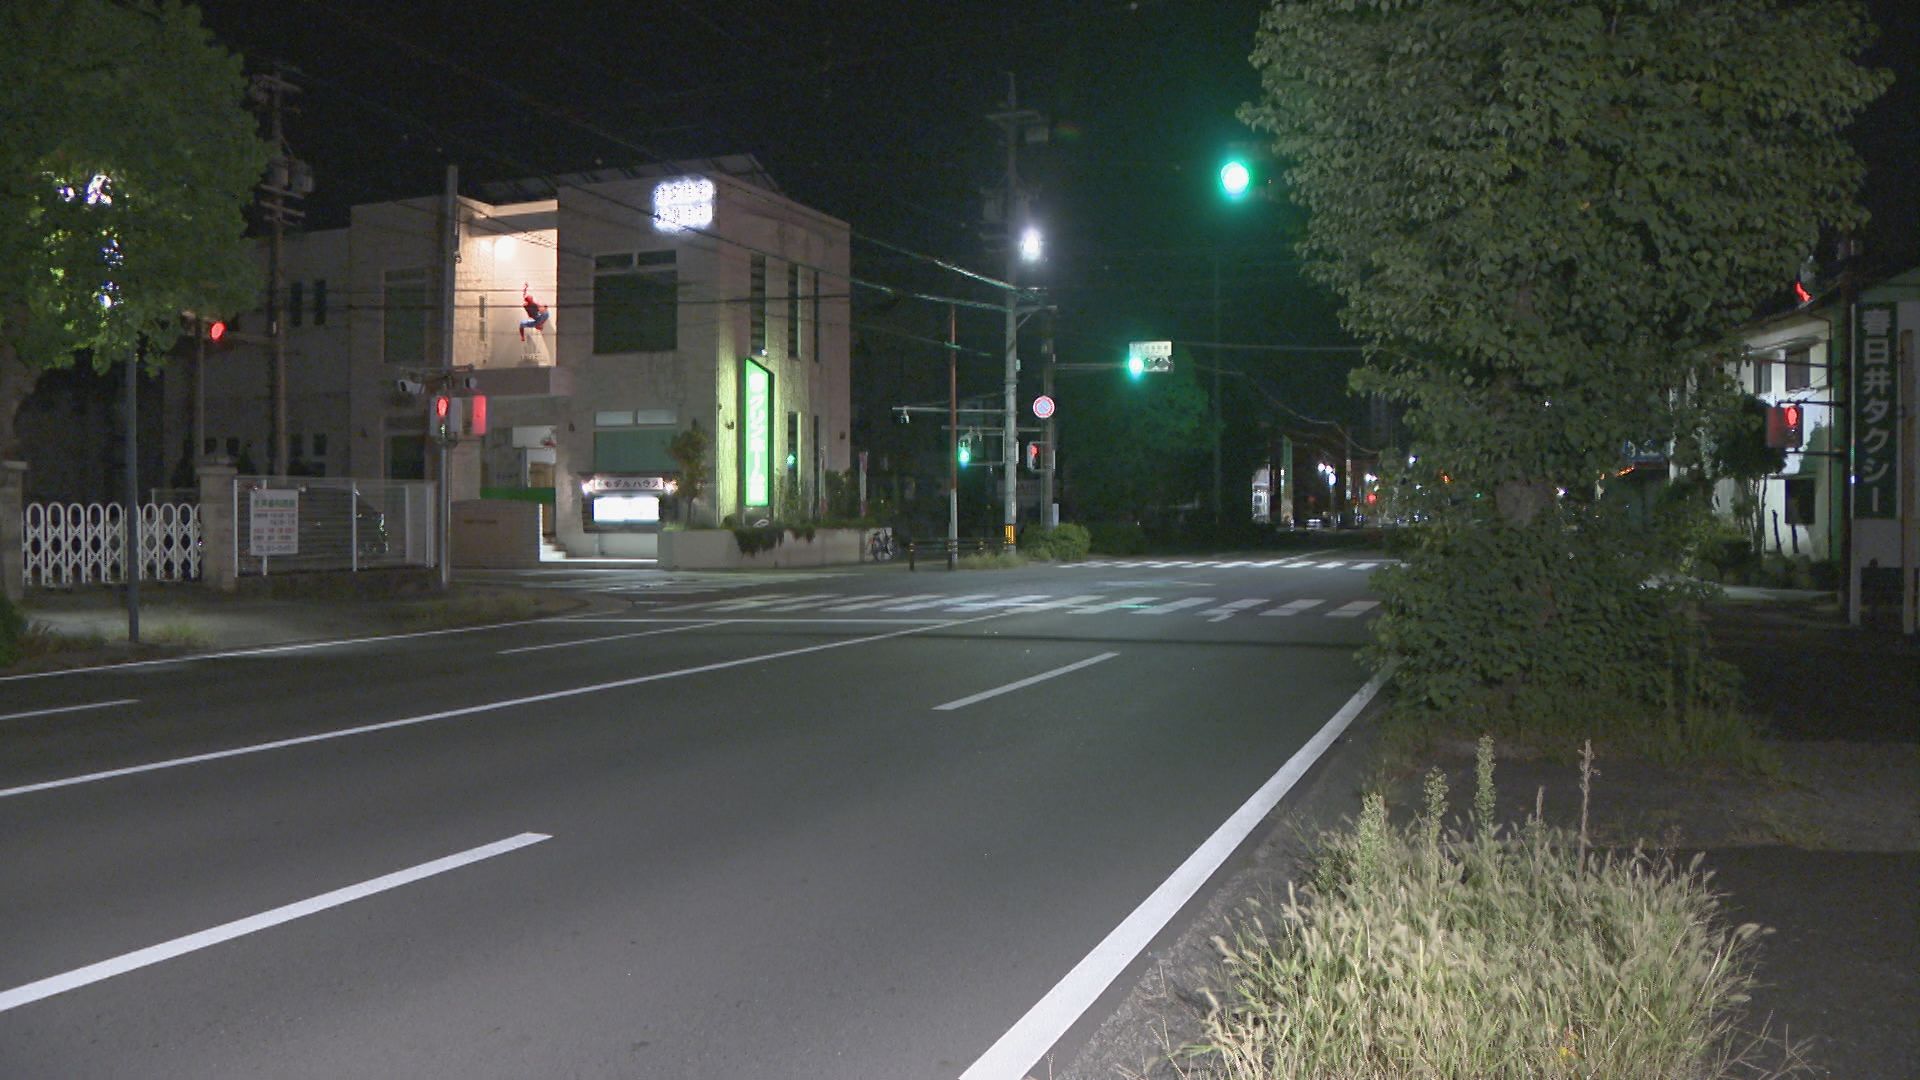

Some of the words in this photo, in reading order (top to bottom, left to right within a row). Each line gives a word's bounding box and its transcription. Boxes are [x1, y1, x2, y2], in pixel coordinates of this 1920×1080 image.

[1862, 309, 1892, 512] 春日井タクシー
[604, 479, 660, 489] モデルハウス
